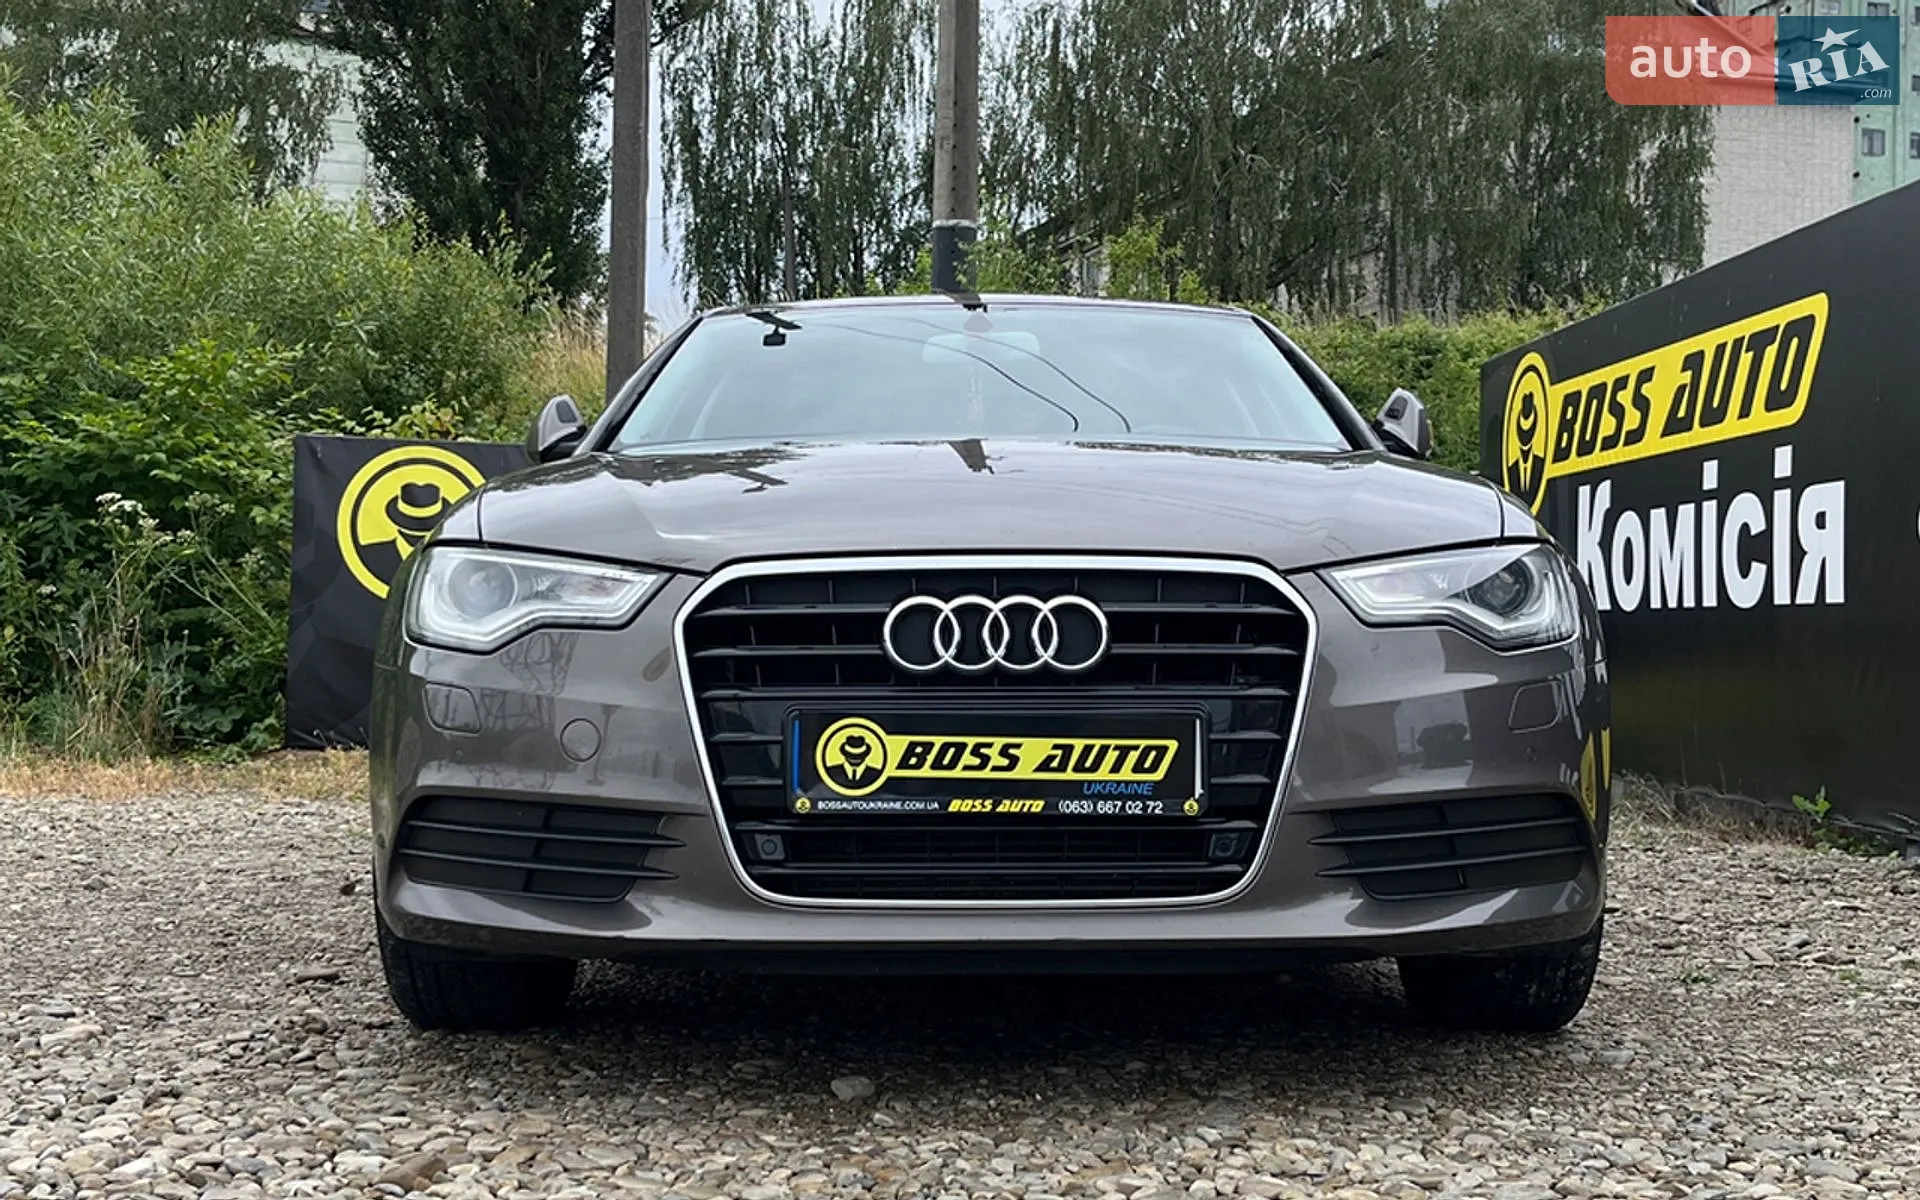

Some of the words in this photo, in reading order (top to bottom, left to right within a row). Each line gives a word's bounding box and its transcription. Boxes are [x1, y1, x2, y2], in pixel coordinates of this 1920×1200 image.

[1551, 365, 1656, 465] BOSS
[1659, 313, 1816, 439] AUTO
[1577, 444, 1846, 613] Комісія
[895, 740, 1024, 773] BOSS
[1033, 743, 1170, 775] AUTO
[1082, 782, 1154, 796] UKRAINE
[817, 800, 940, 810] BOSSAUTOUKRAINE.COM.UA
[947, 799, 993, 813] BOSS
[995, 799, 1046, 813] AUTO
[1058, 800, 1094, 814] (063)
[1096, 801, 1122, 814] 667
[1125, 801, 1143, 814] 02
[1147, 801, 1163, 814] 72
